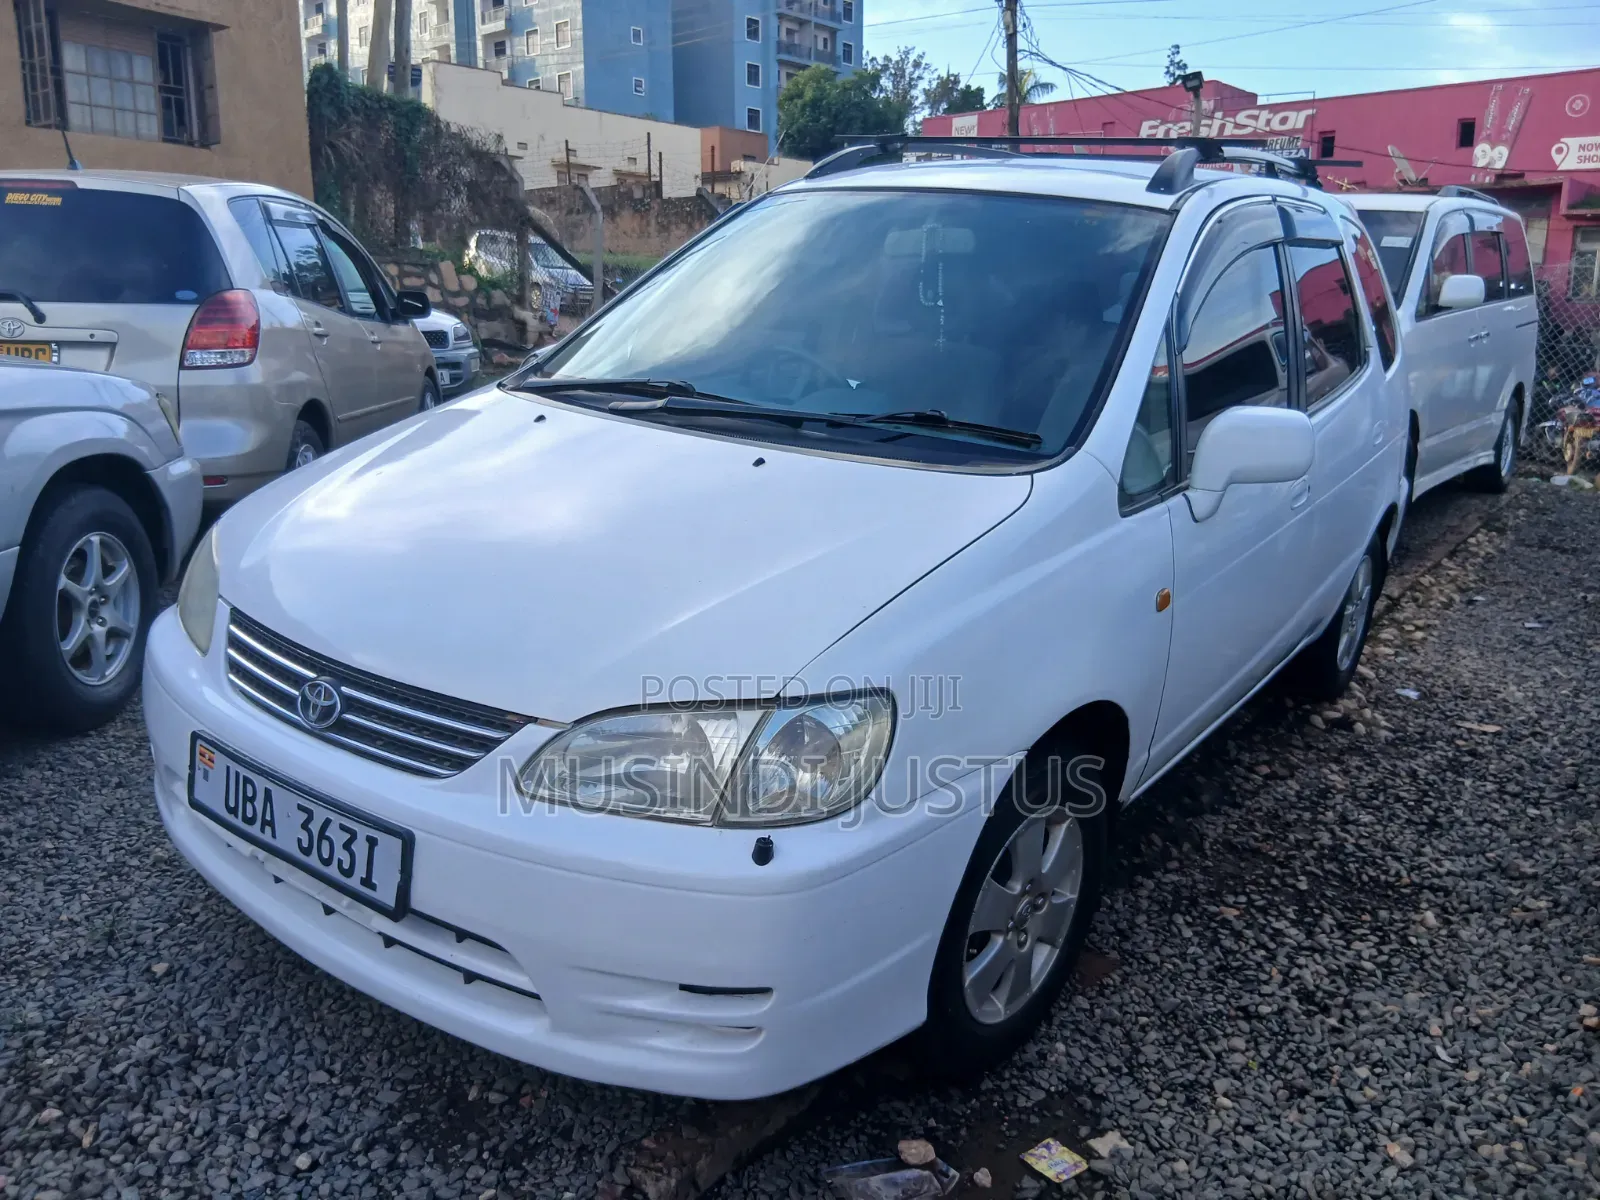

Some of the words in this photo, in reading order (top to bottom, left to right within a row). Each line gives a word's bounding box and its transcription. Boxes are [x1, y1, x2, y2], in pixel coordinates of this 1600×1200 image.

[1139, 109, 1316, 138] FreshStar
[1576, 154, 1600, 164] SHO
[224, 765, 277, 839] UBA
